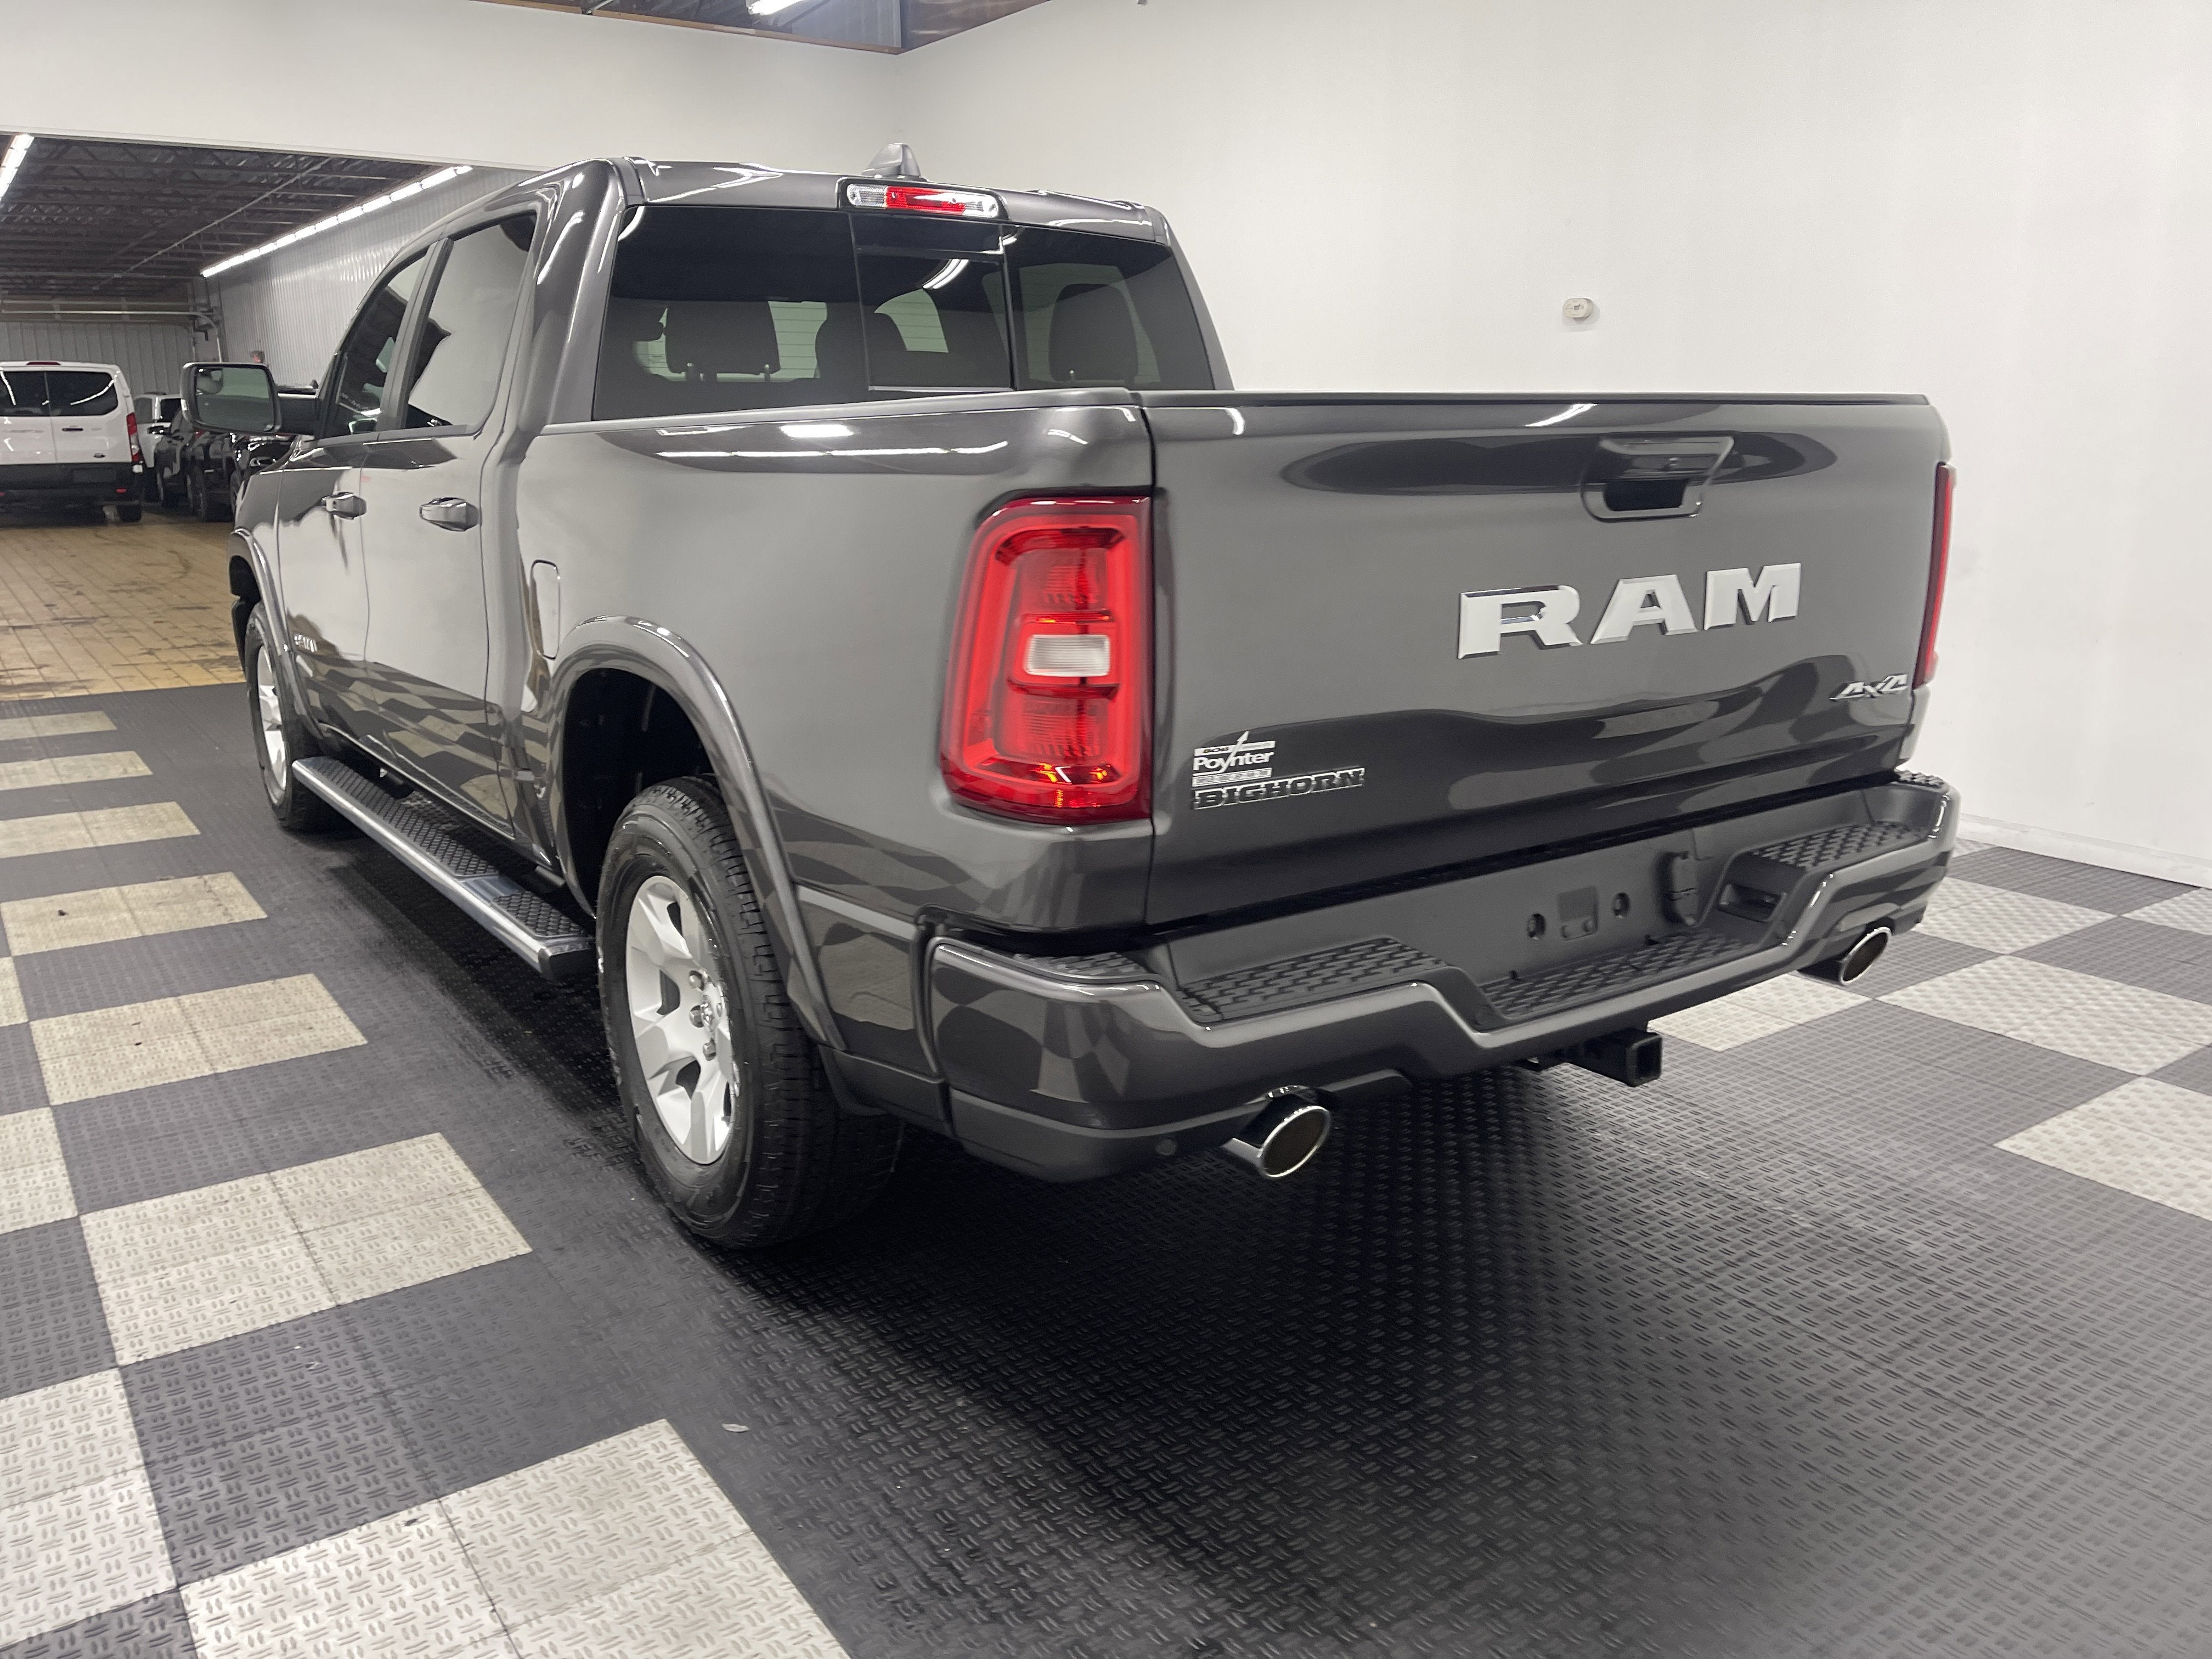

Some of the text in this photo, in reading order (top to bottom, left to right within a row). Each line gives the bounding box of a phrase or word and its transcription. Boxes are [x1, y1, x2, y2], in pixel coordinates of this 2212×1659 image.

[1458, 562, 1801, 659] RAM
[1193, 752, 1275, 771] Poynter
[1193, 768, 1365, 810] BIGHORN
